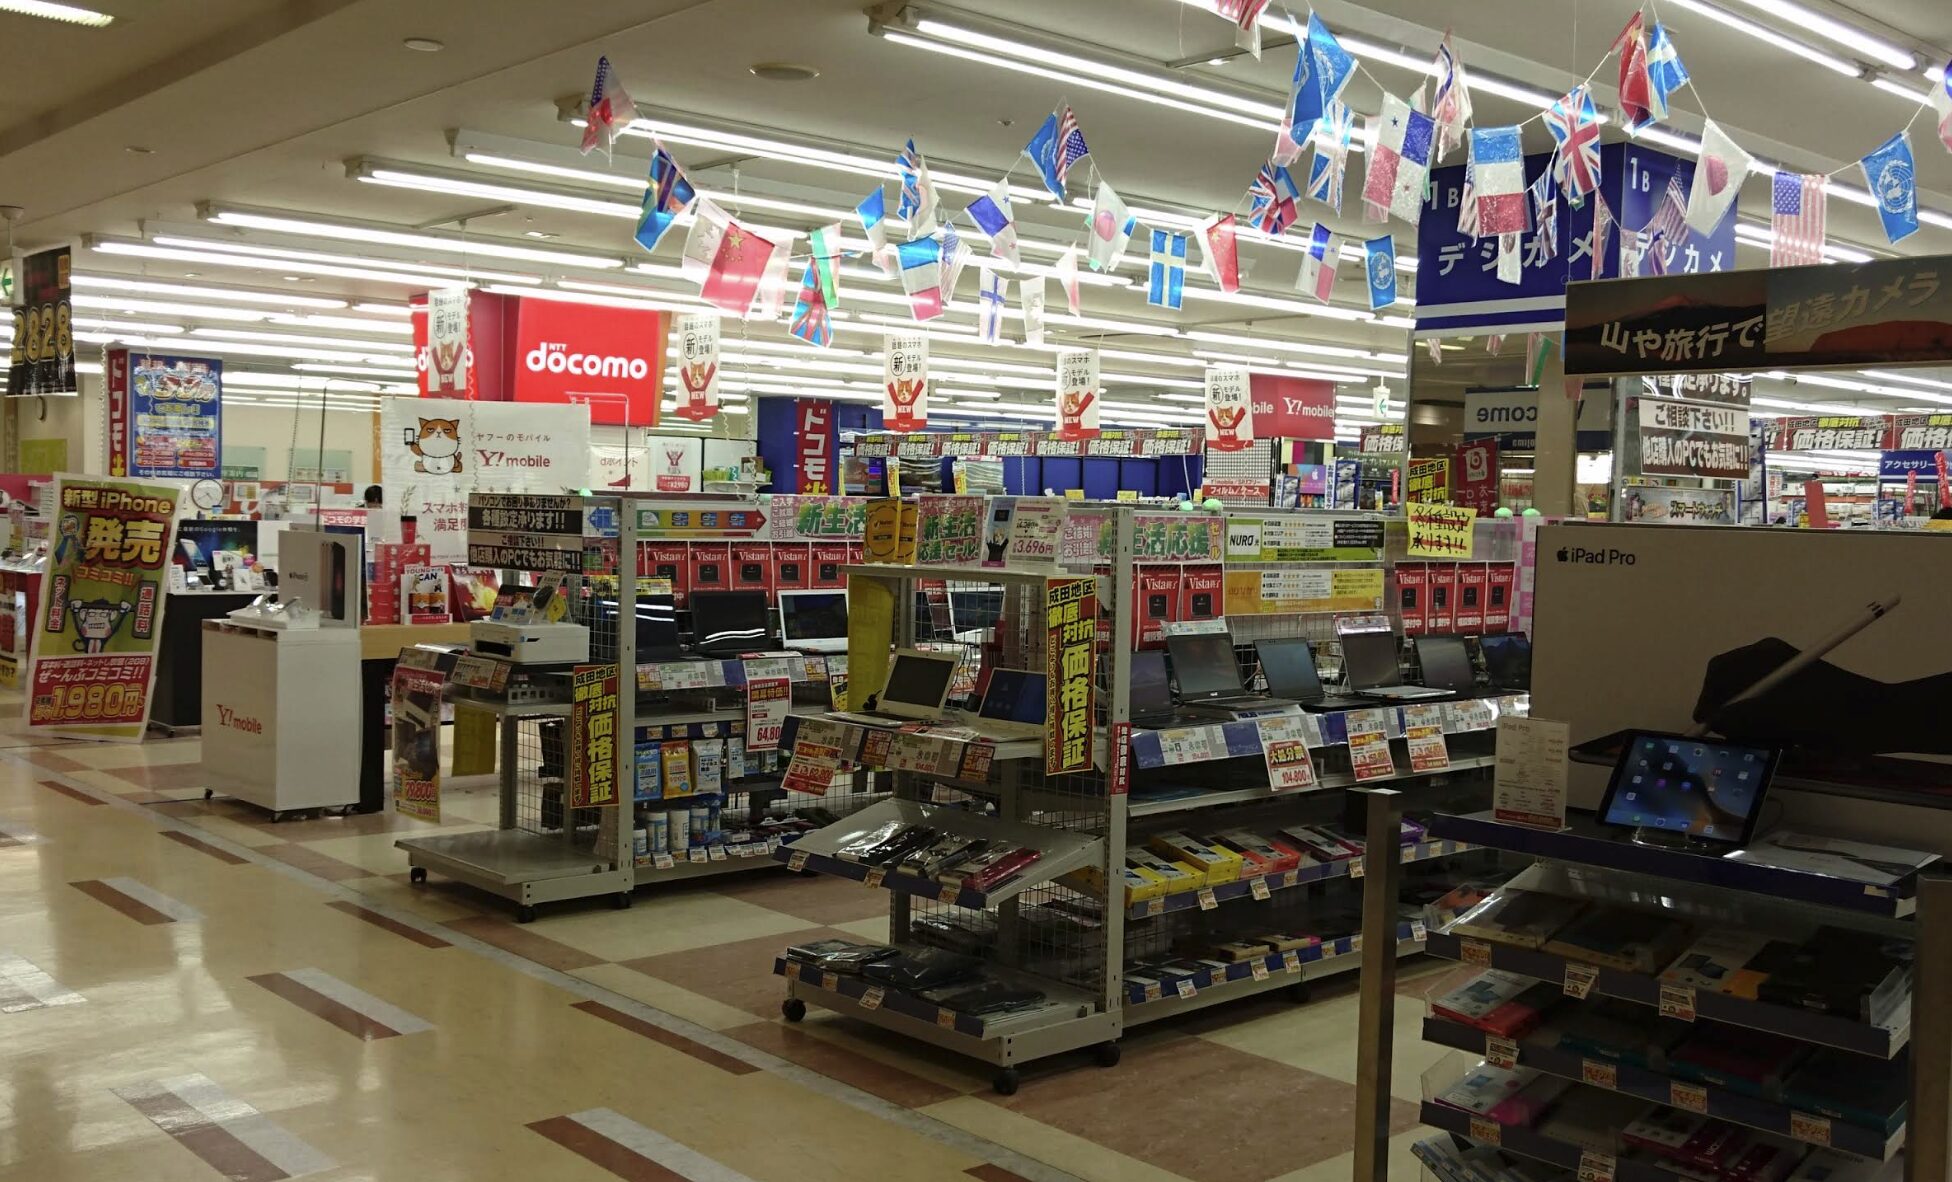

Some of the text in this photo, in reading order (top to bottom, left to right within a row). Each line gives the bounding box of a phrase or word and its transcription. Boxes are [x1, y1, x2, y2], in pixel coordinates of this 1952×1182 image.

[12, 301, 72, 364] 2828
[550, 343, 567, 351] NTT
[686, 338, 696, 354] 新
[526, 342, 648, 380] docomo
[893, 356, 903, 372] 新
[1212, 388, 1220, 402] 新
[1655, 403, 1735, 433] ご相談下さい!!
[803, 407, 829, 481] ドコモ
[1792, 429, 1882, 449] 価格保証!
[1410, 460, 1446, 477] 成田地区
[63, 488, 171, 514] 新型 iPhone
[482, 510, 565, 530] 各種設定承ります!!
[85, 515, 165, 564] 発売
[1571, 547, 1636, 566] iPad Pro
[76, 565, 134, 586] コミコミ!!
[1048, 579, 1095, 602] 成田地区
[1047, 602, 1080, 628] 徹底
[1062, 618, 1095, 643] 対抗
[575, 665, 617, 685] 成田地区
[588, 693, 617, 713] 対抗
[1060, 643, 1090, 769] 価格保証
[757, 726, 781, 742] 64,80
[587, 712, 614, 804] 価格保証
